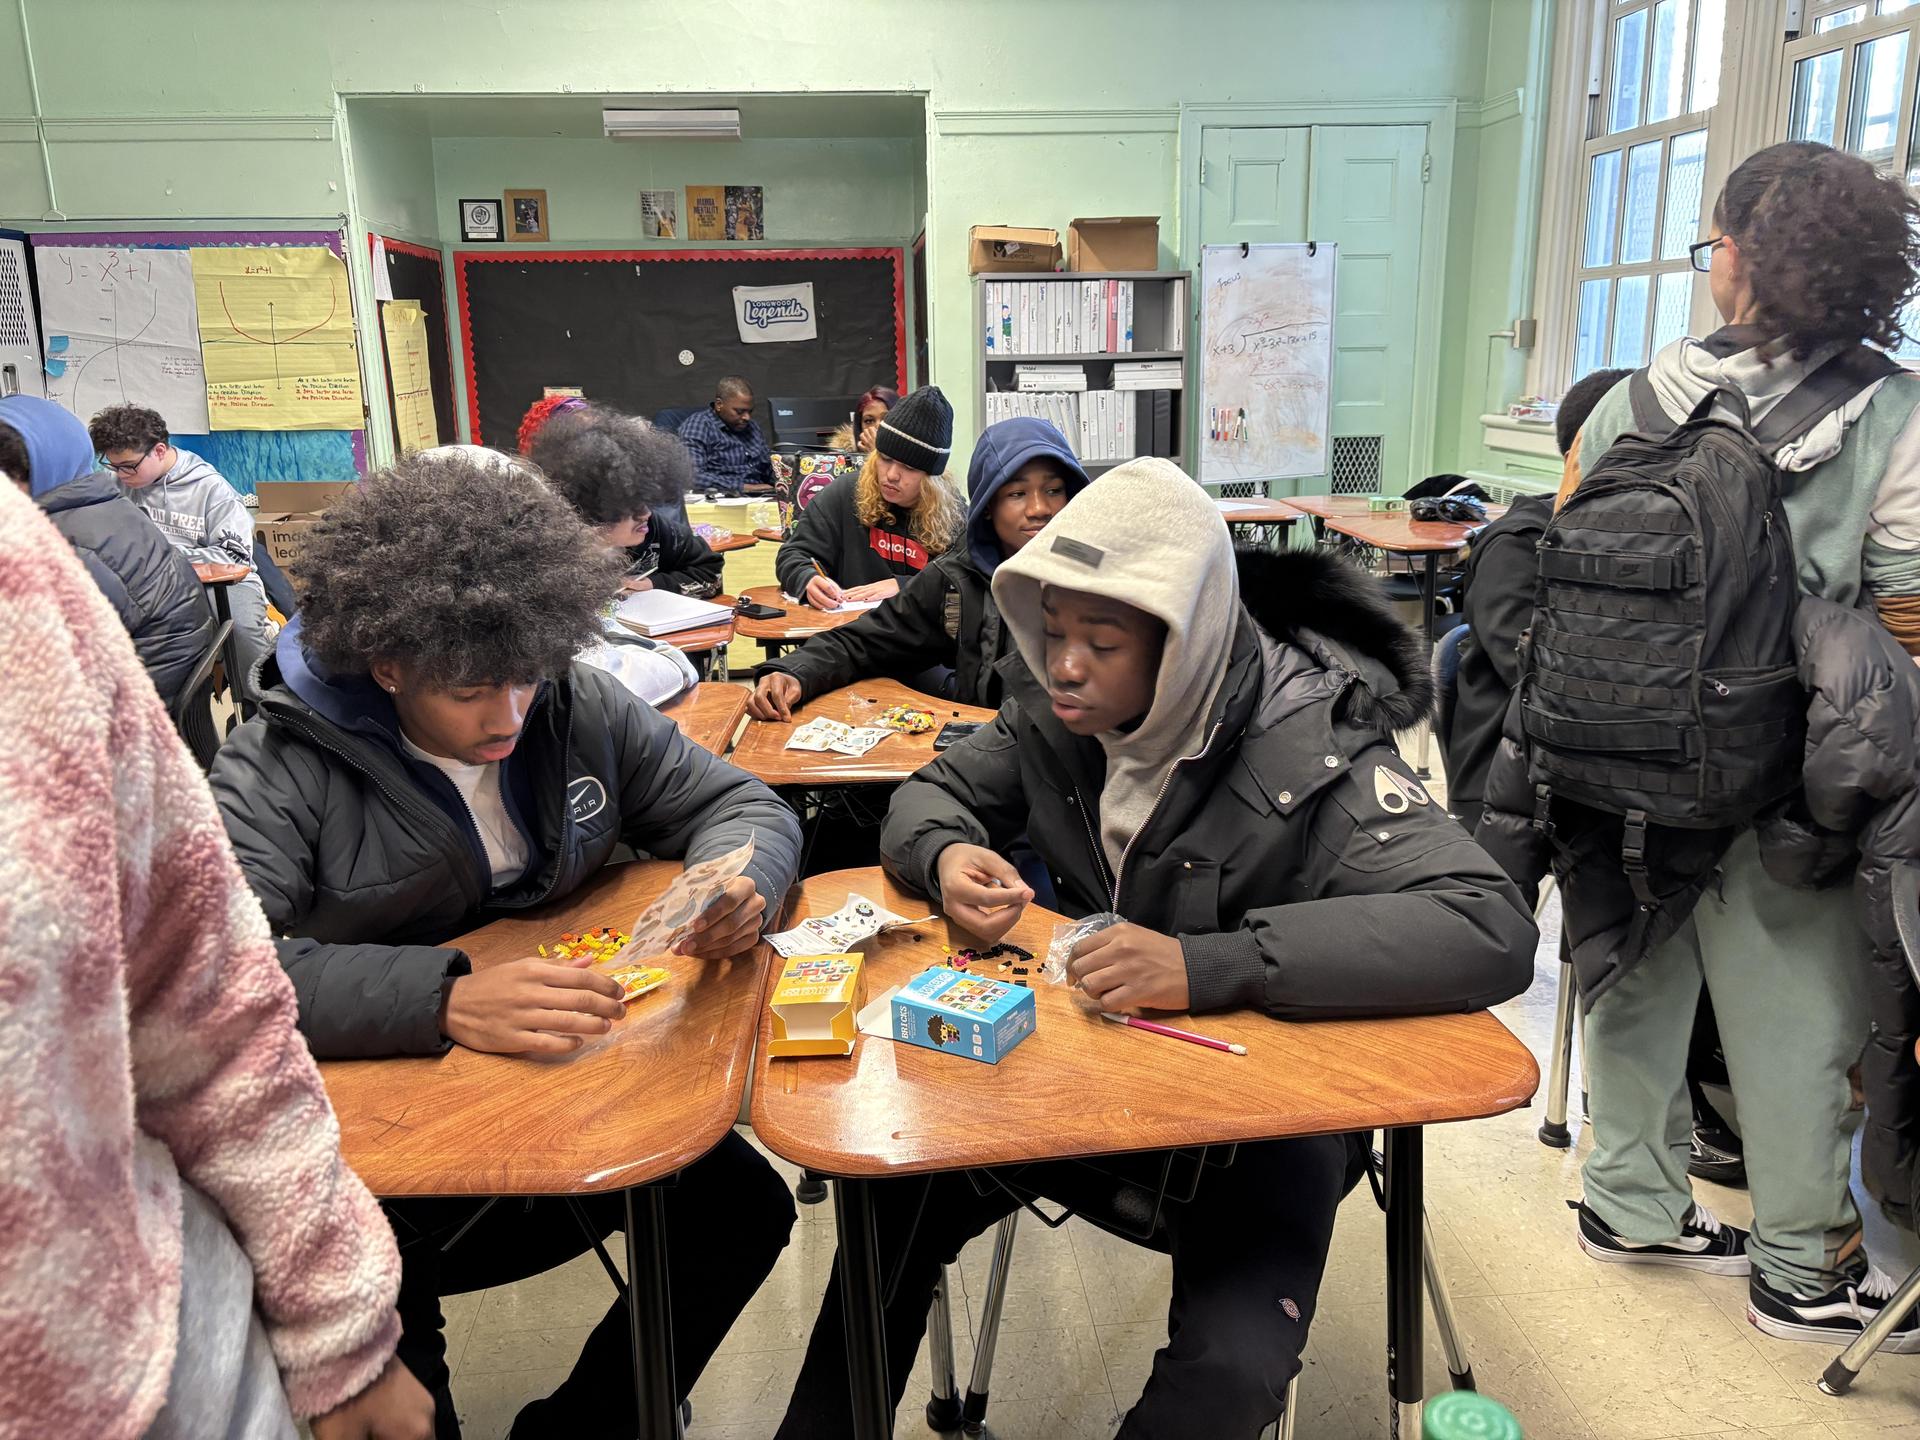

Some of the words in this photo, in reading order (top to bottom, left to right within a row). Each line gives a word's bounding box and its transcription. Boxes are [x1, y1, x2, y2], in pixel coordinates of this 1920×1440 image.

[752, 299, 792, 307] LONGWOOD
[744, 298, 809, 329] Legends
[169, 511, 205, 531] PREP
[272, 530, 303, 543] ima
[275, 546, 302, 559] lea
[573, 799, 596, 814] AIR
[899, 1005, 909, 1040] BRICKS
